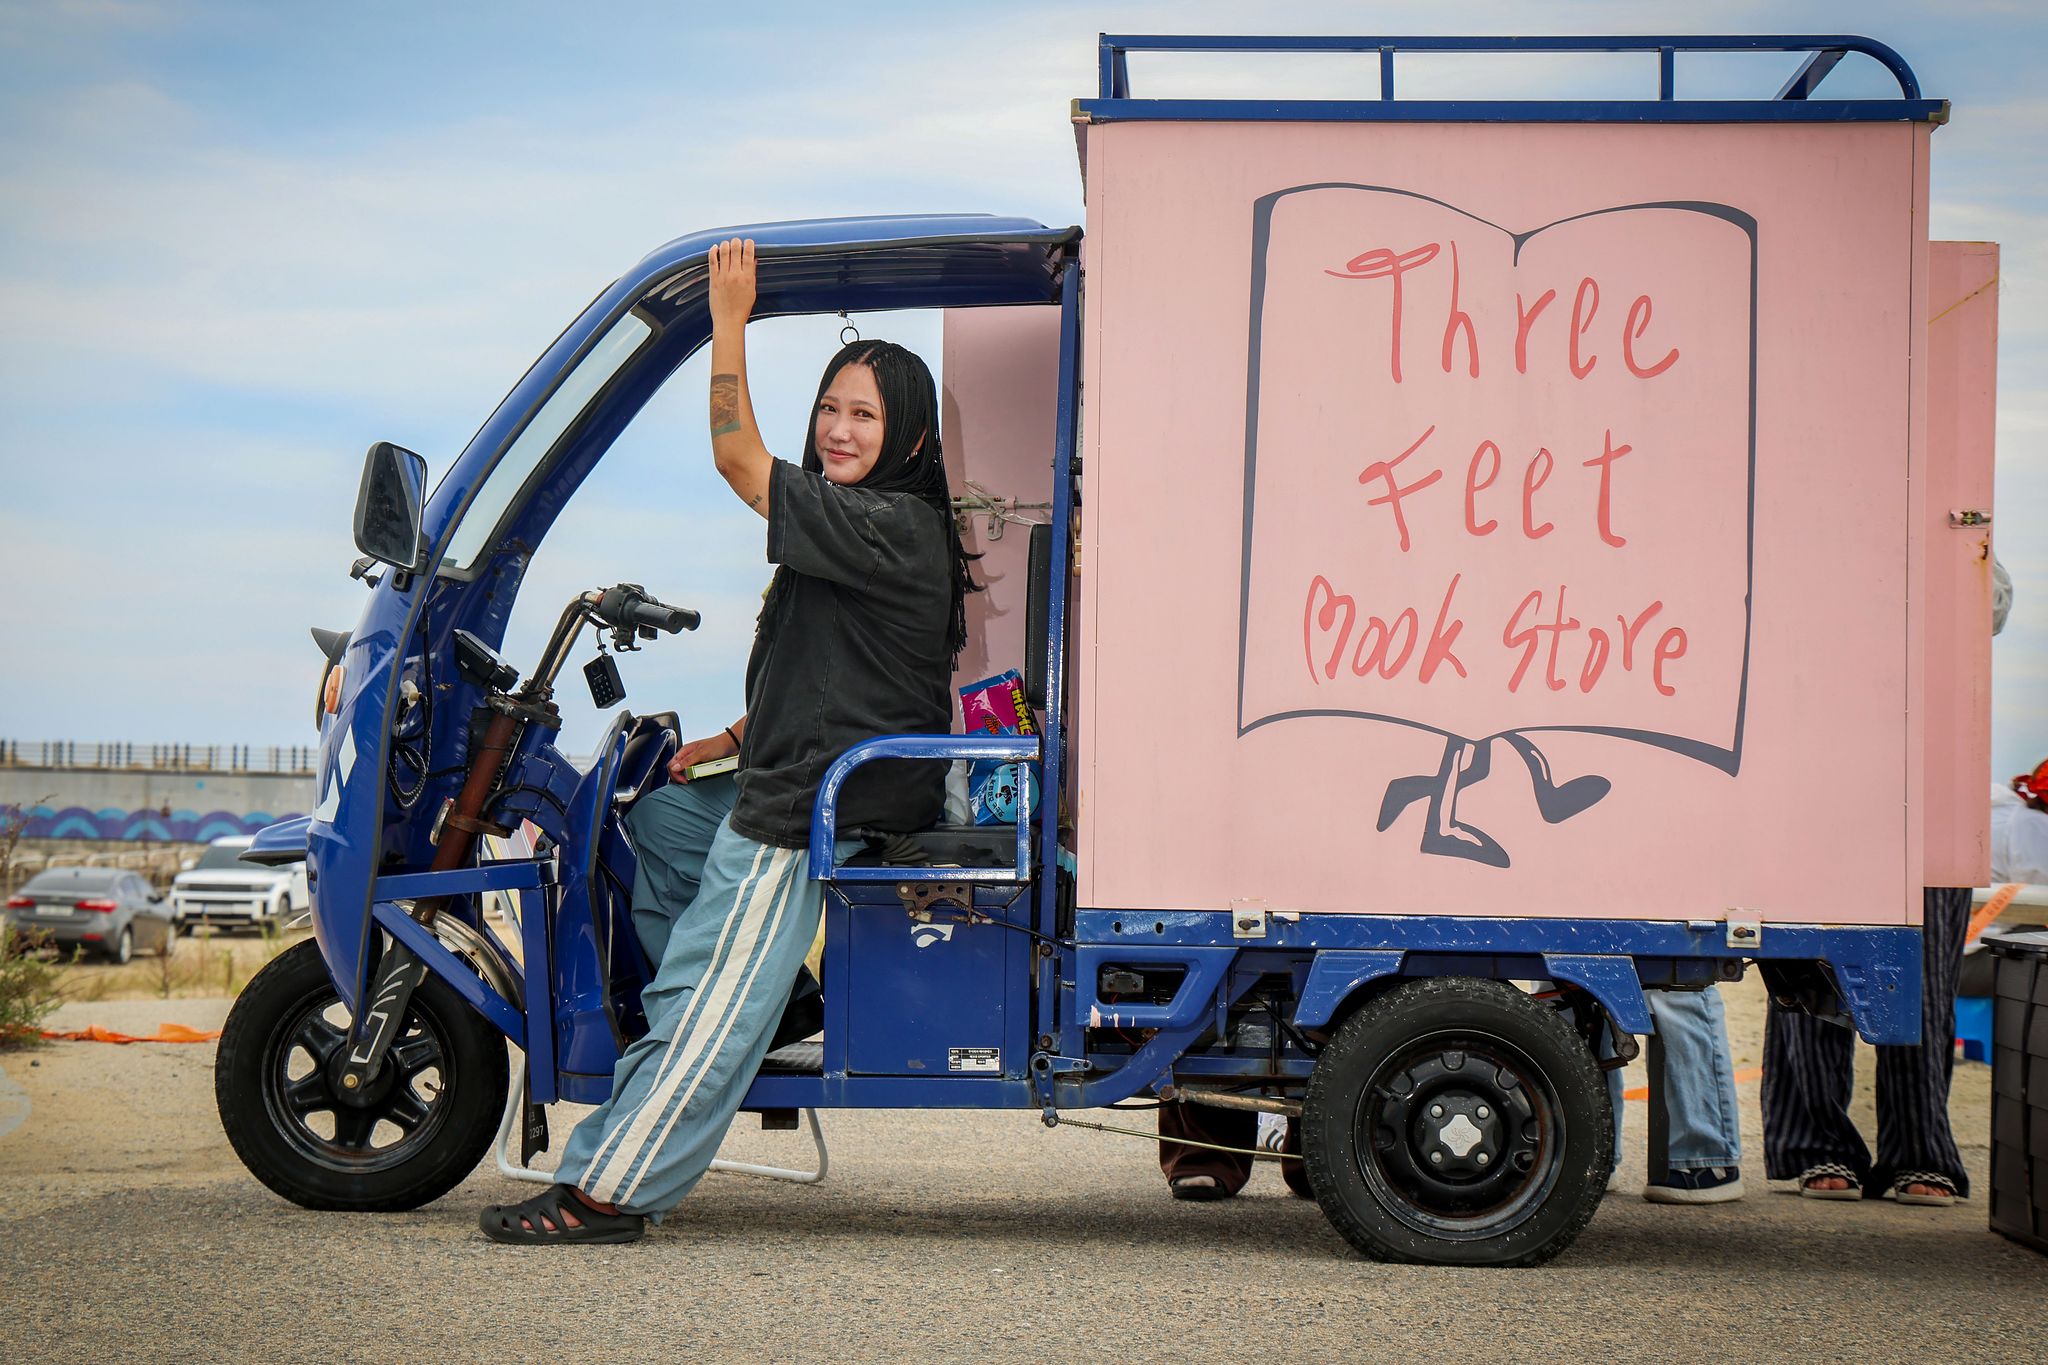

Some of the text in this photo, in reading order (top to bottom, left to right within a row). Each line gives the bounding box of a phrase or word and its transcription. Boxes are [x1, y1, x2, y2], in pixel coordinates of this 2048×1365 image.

[1325, 241, 1679, 383] Three
[1359, 425, 1632, 552] Feet
[1304, 573, 1688, 697] Book Store
